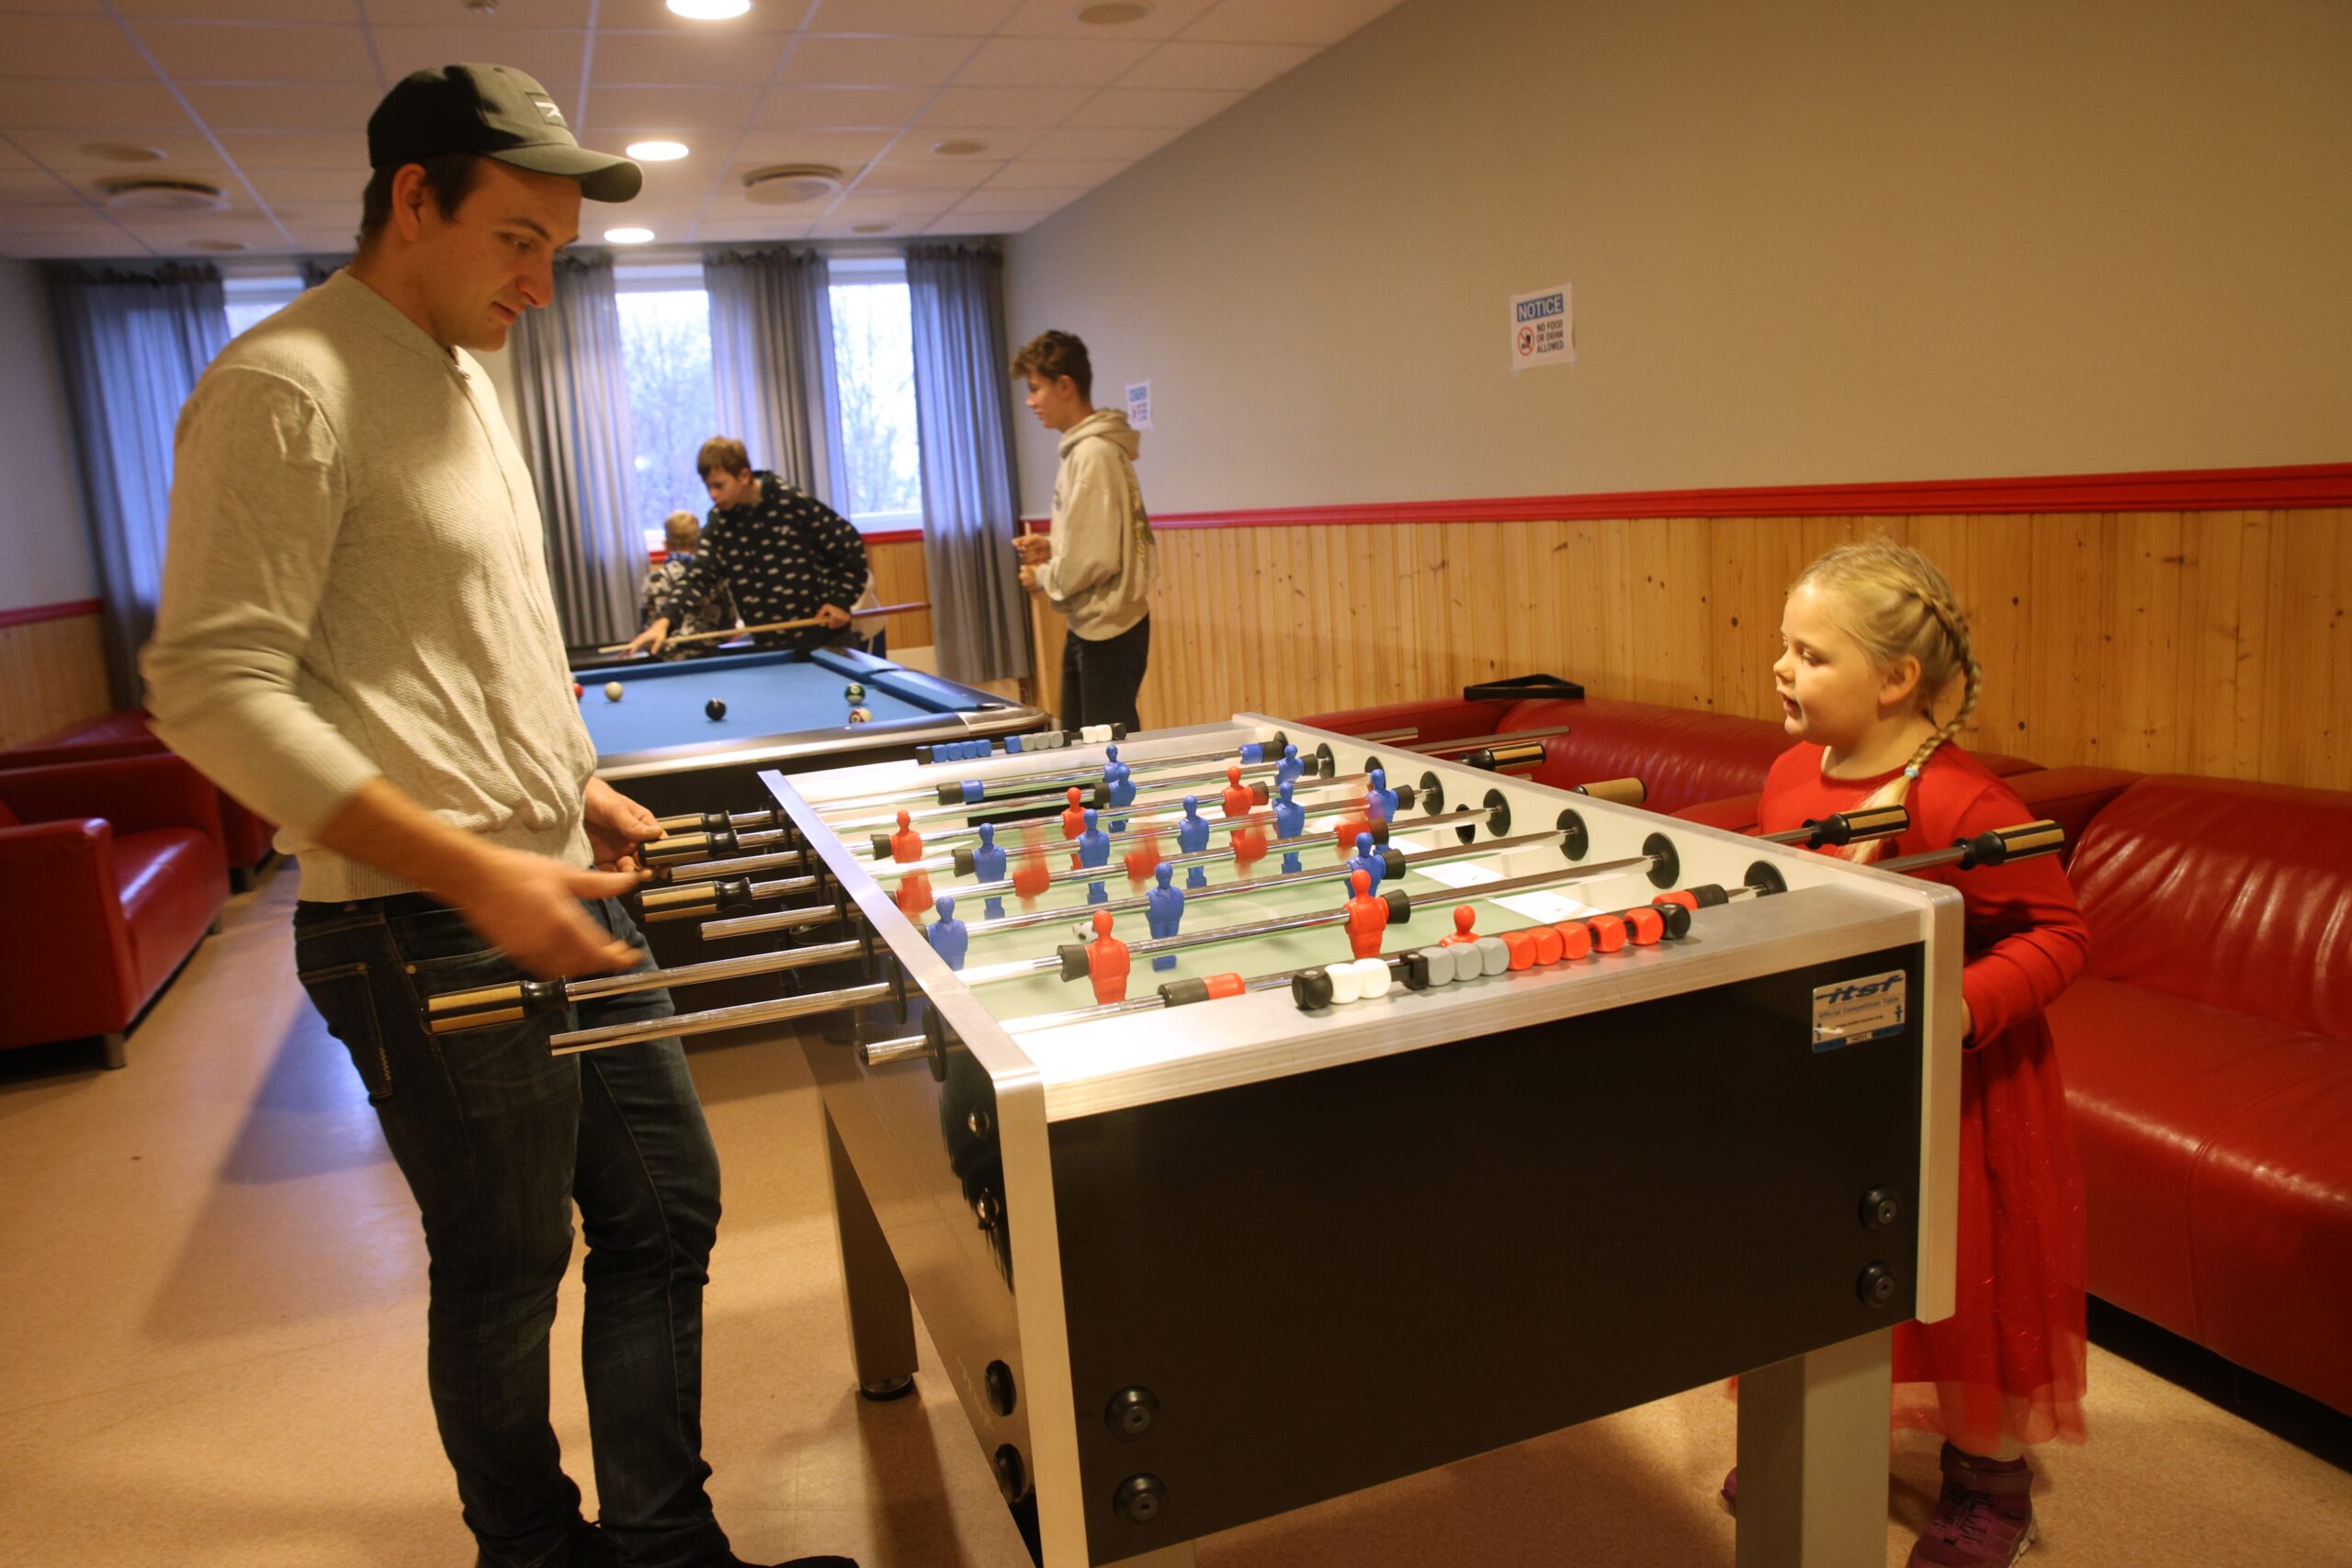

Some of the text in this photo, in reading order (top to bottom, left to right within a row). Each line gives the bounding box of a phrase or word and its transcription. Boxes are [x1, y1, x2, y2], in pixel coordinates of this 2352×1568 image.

[1518, 296, 1562, 321] NOTICE
[1536, 320, 1563, 332] NO FOOD
[1536, 331, 1564, 342] OR DRINK
[1537, 340, 1564, 353] ALLOWED
